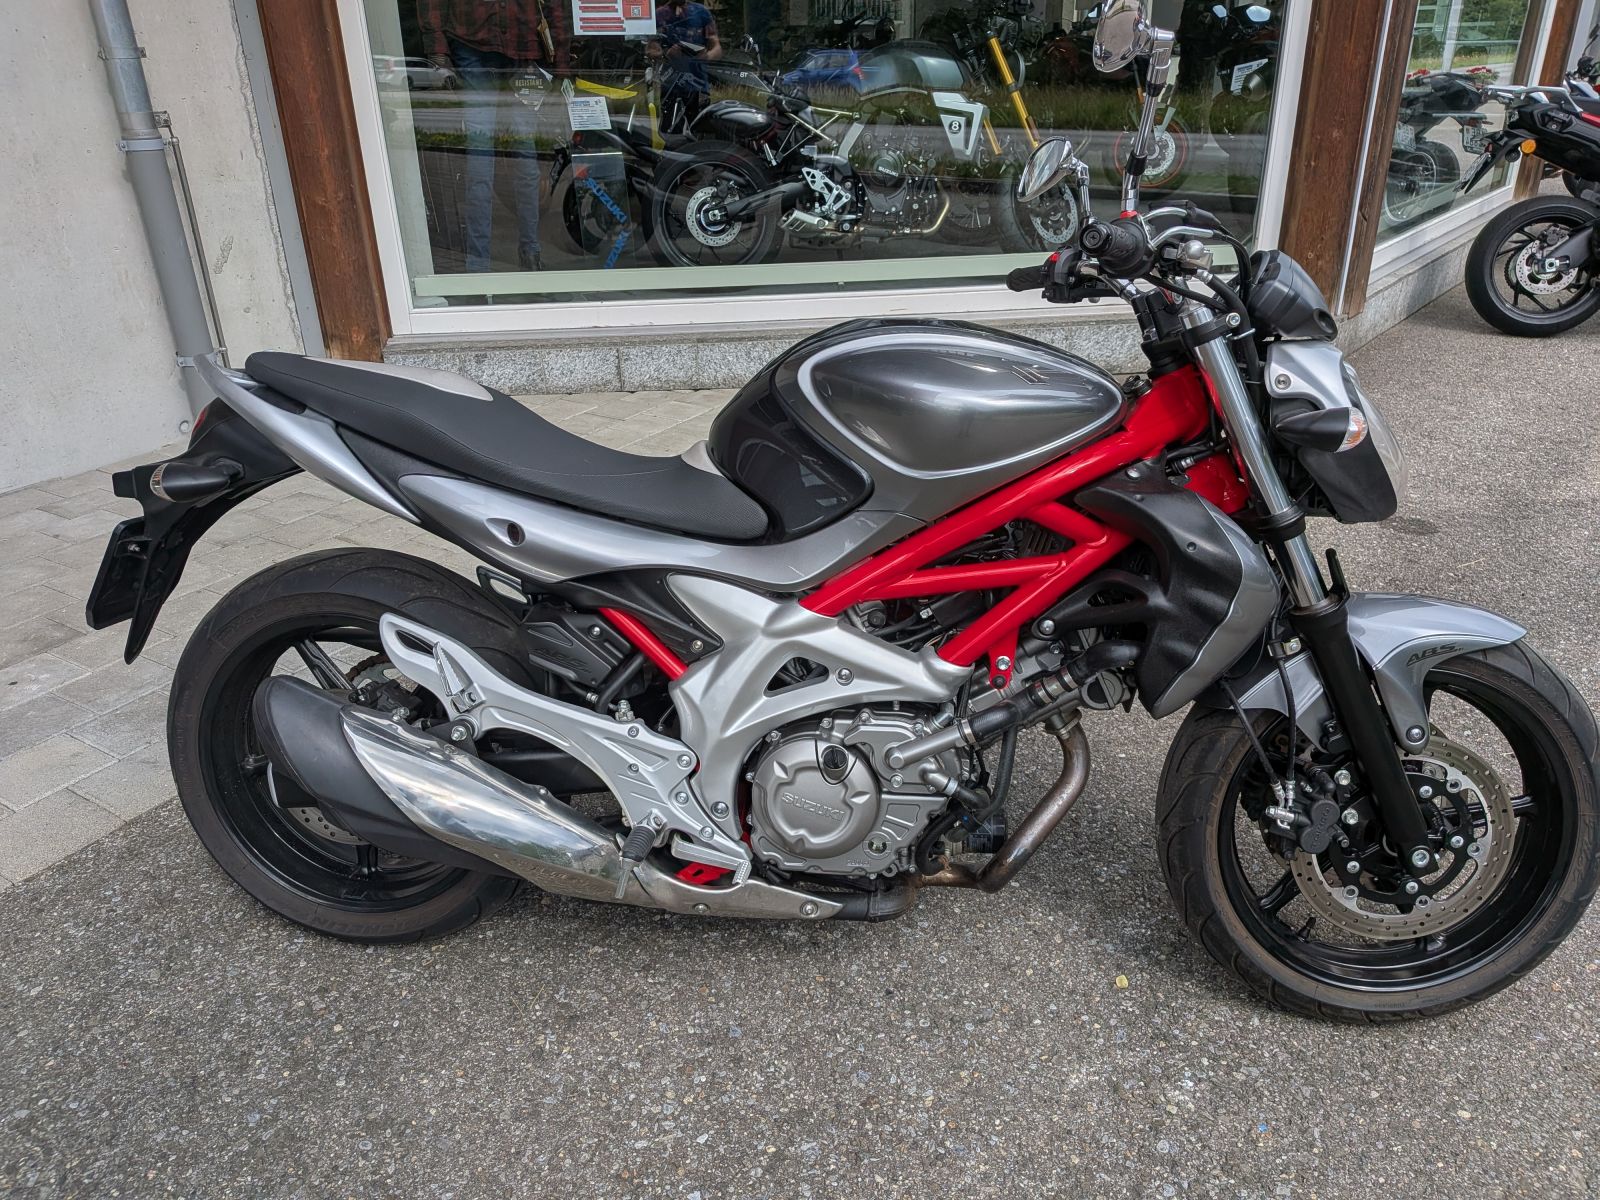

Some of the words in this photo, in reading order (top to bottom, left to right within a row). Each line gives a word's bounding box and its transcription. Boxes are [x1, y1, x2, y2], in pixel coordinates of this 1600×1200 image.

[952, 121, 960, 131] 8
[878, 165, 899, 177] SUZUKI
[583, 176, 628, 223] SUZUKI
[781, 791, 846, 822] SUZUKI
